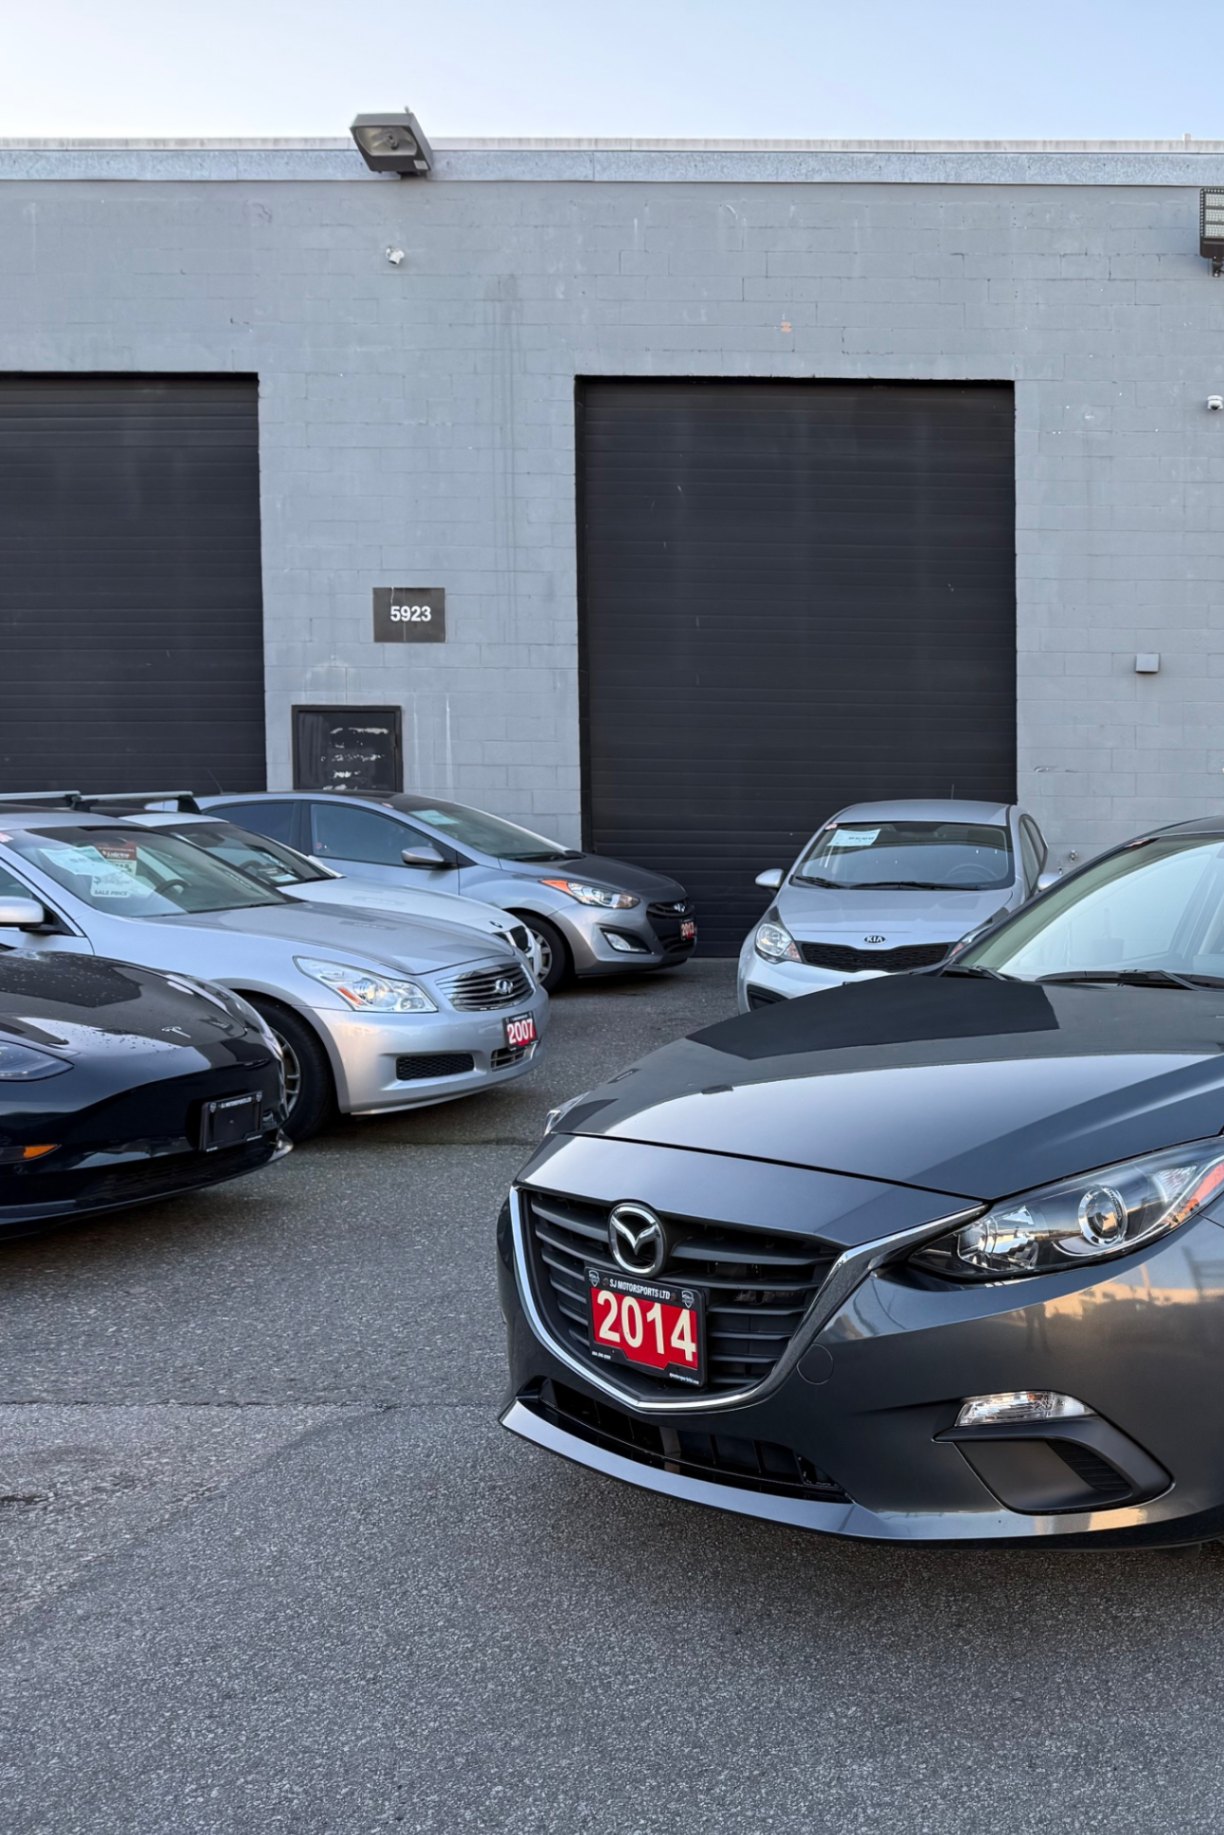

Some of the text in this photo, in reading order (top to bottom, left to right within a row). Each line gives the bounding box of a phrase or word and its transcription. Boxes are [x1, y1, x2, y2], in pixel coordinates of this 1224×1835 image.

[390, 605, 432, 622] 5923
[506, 1018, 533, 1044] 2007
[609, 1278, 671, 1300] SJ MOTORSPORTS LTD
[597, 1290, 697, 1362] 2014
